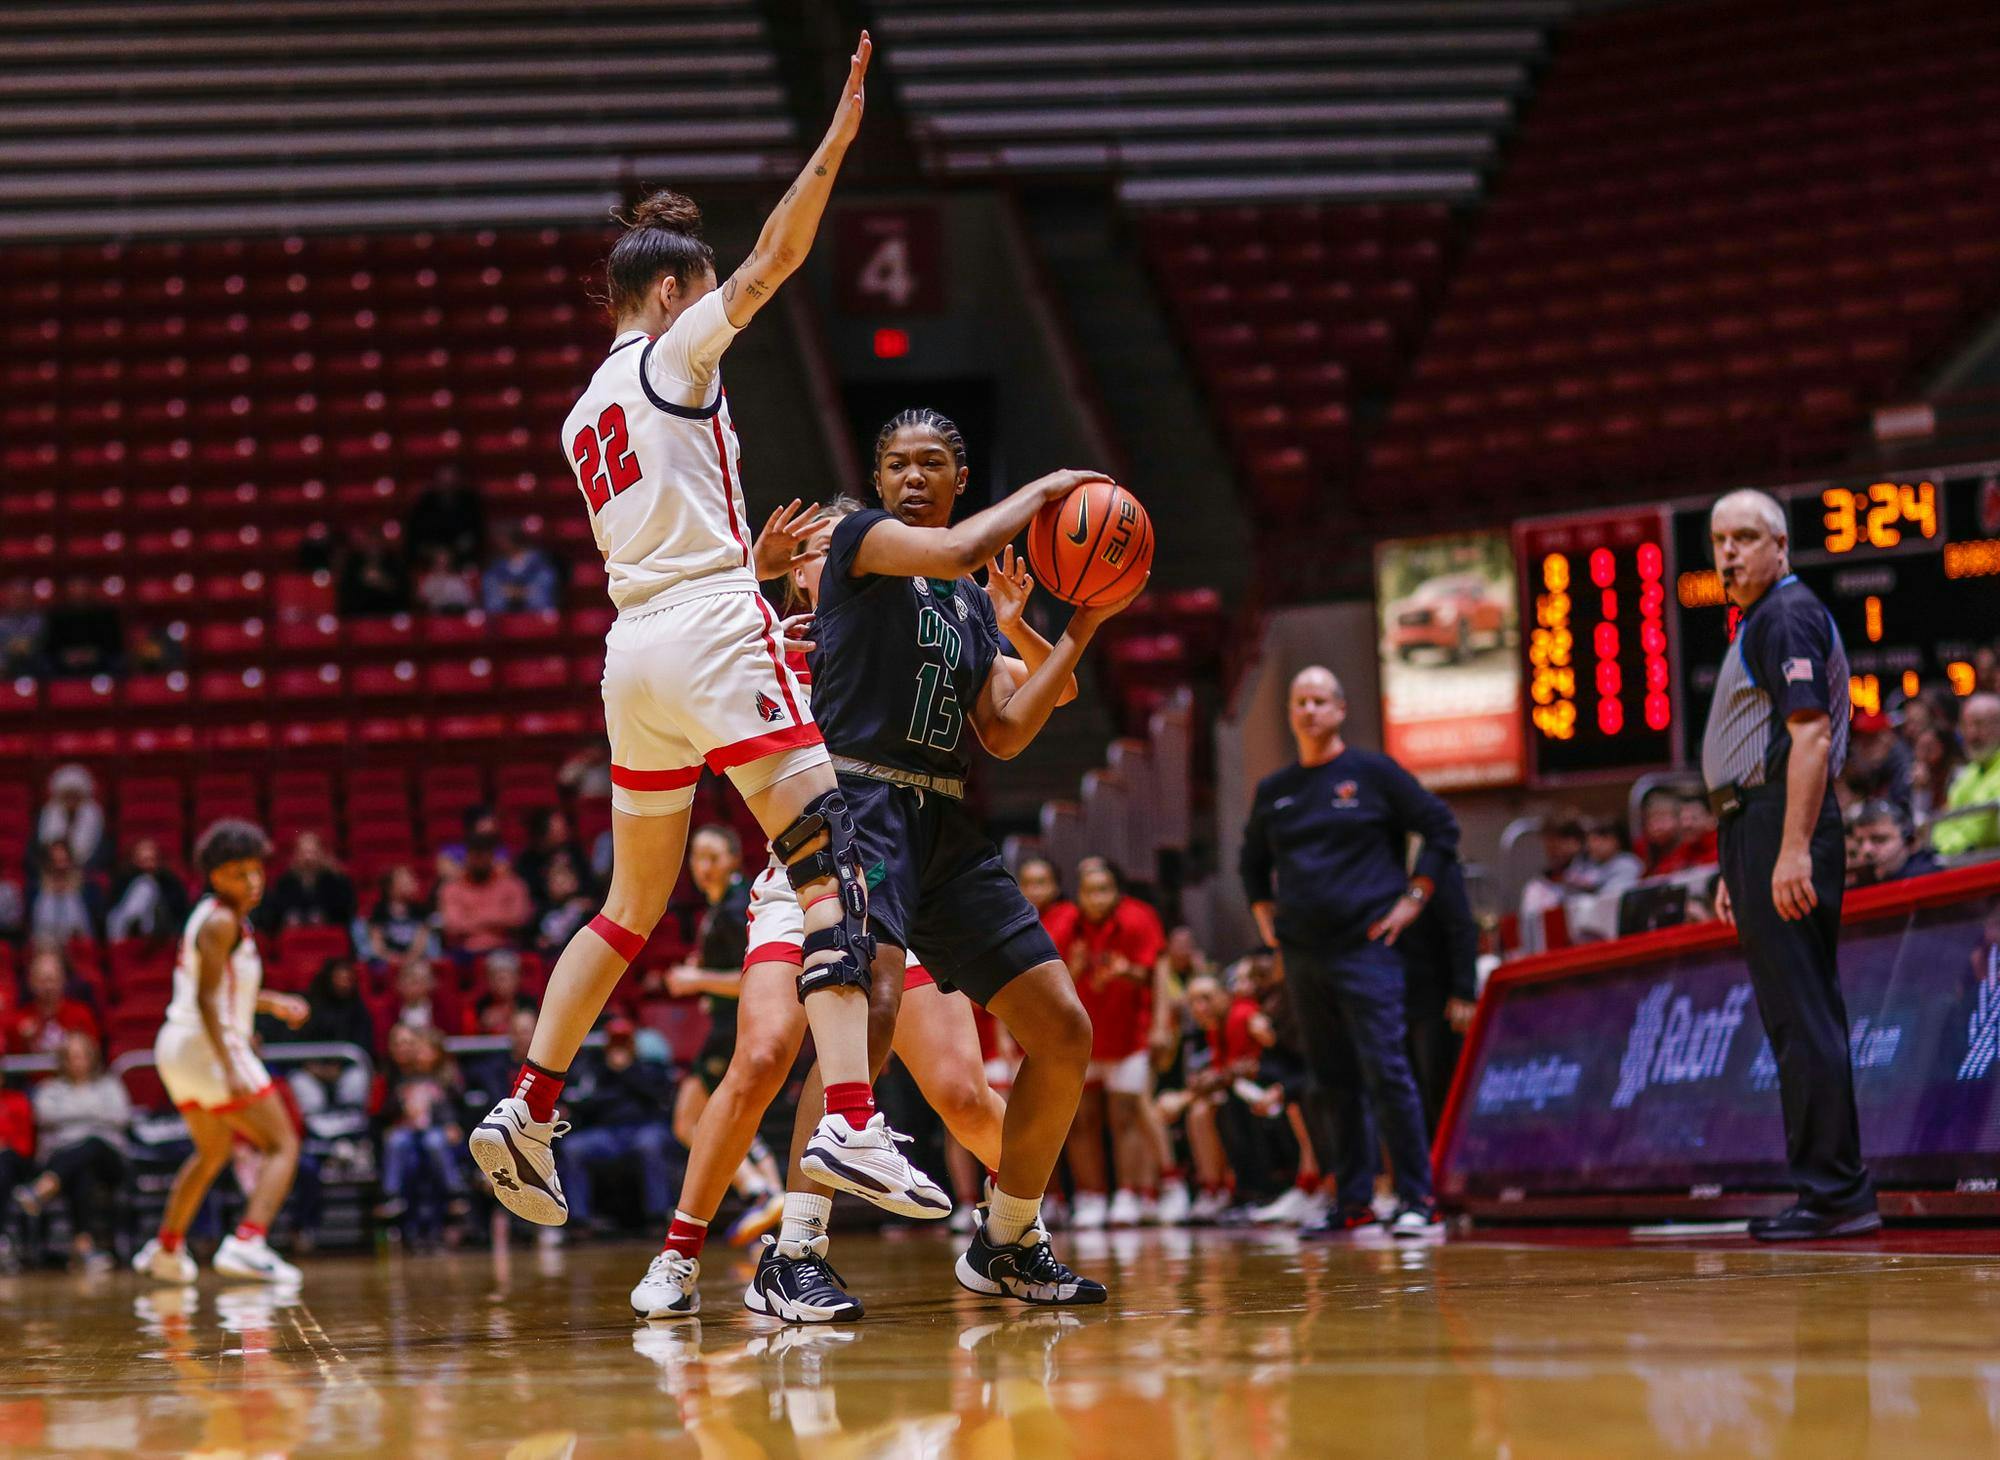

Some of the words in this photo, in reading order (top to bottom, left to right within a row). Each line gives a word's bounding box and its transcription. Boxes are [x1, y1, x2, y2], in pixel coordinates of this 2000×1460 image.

[857, 238, 917, 305] 4
[573, 402, 643, 517] 22
[1101, 498, 1137, 569] ELITE
[1822, 480, 1937, 553] 3:24
[1865, 595, 1883, 642] 1
